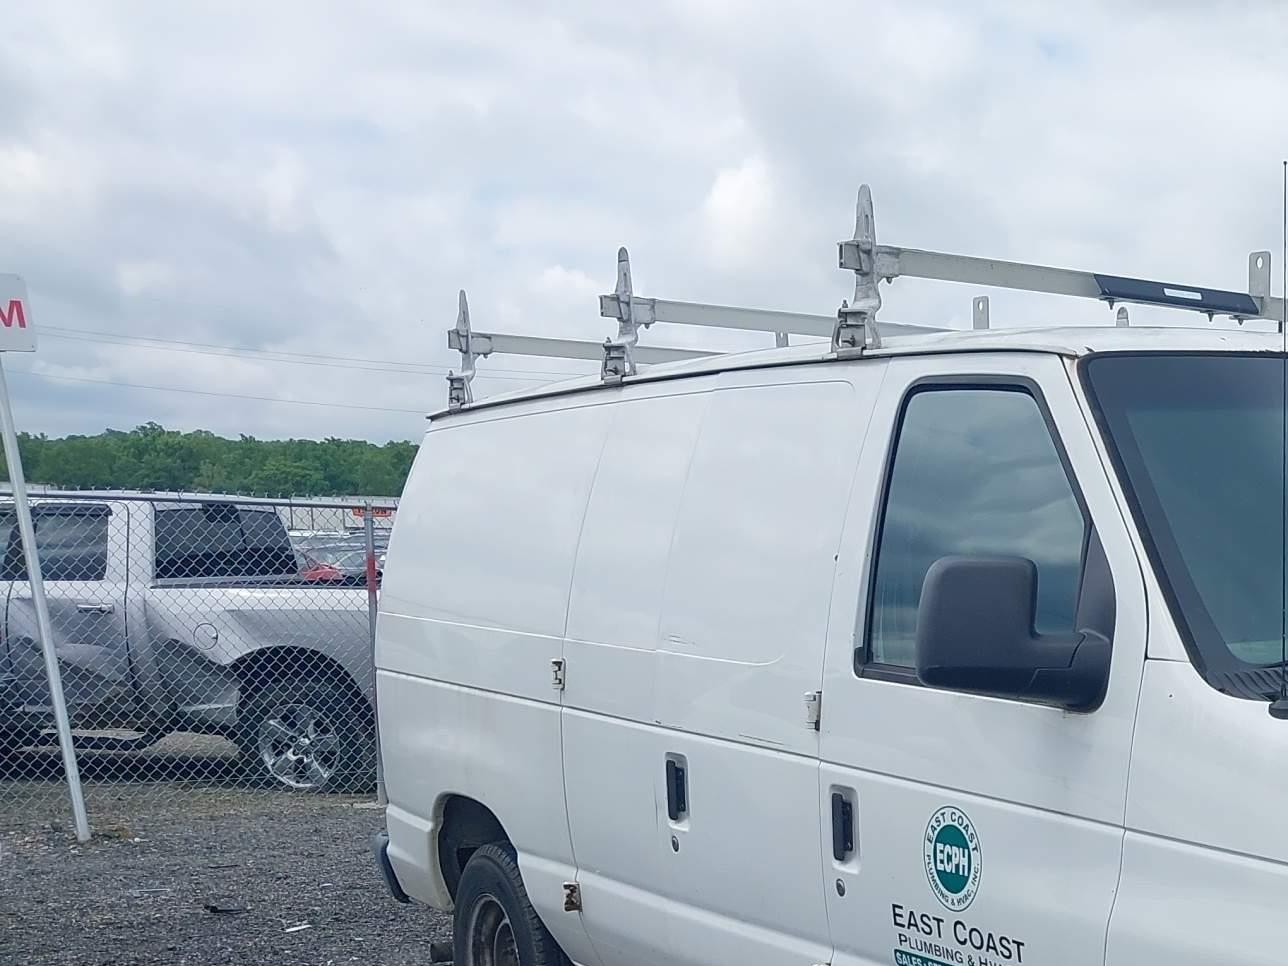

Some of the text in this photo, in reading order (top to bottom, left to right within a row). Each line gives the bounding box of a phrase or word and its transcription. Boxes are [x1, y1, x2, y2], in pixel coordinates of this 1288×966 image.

[926, 811, 979, 853] EAST COAST
[926, 854, 950, 903] PLUMBING
[936, 842, 969, 877] ECPH
[892, 903, 1025, 963] EAST COAST
[898, 933, 964, 964] PLUMBING
